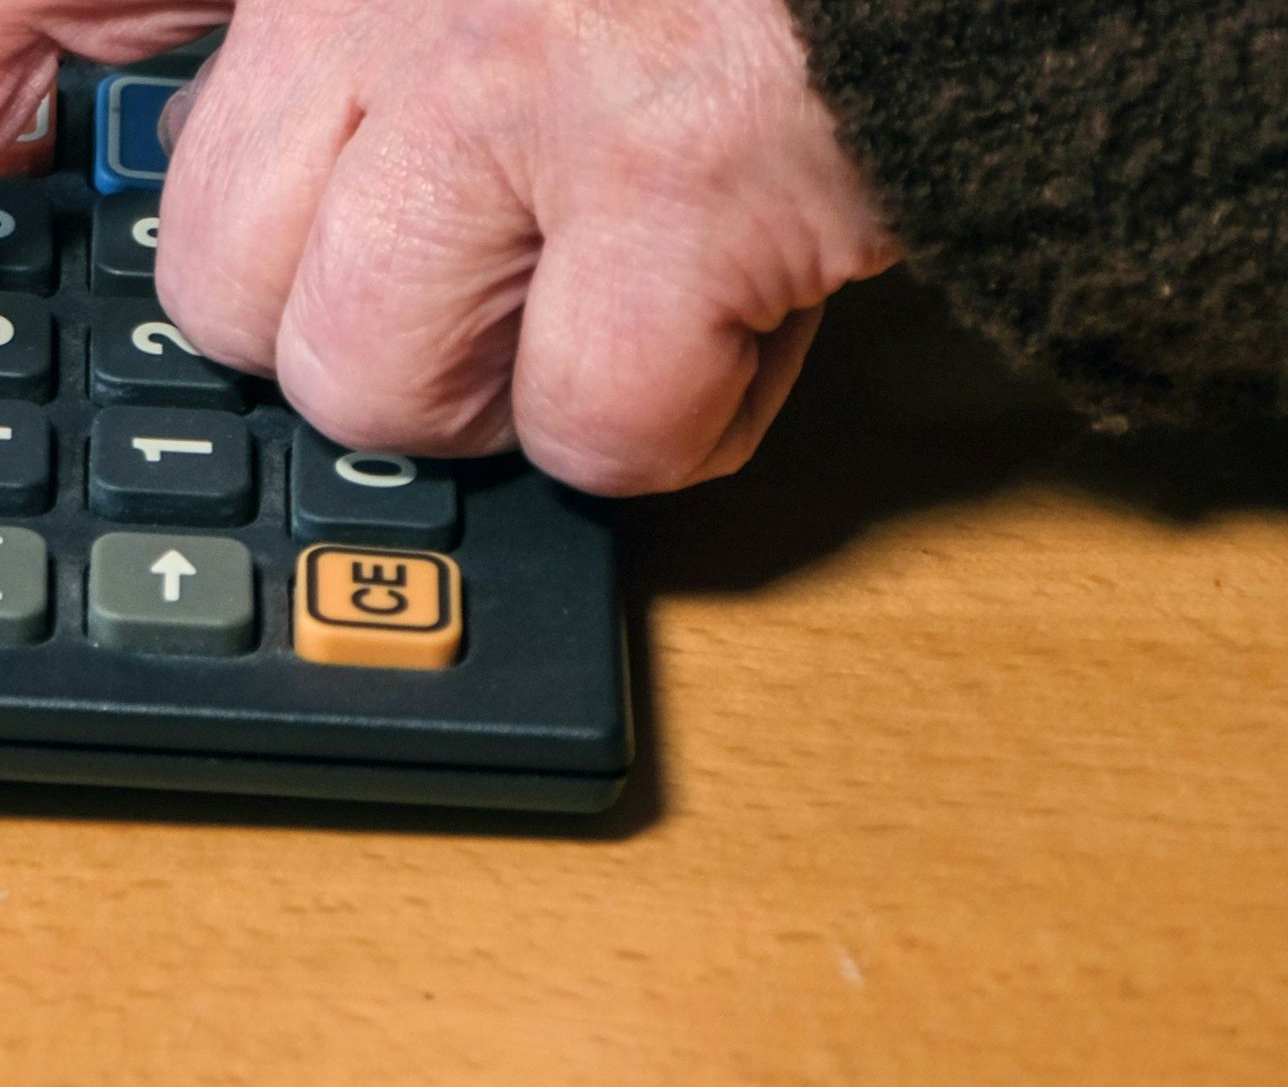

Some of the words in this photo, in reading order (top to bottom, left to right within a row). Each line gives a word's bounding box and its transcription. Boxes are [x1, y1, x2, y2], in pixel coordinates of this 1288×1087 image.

[131, 321, 200, 356] 2
[131, 436, 214, 463] 1
[334, 452, 414, 488] 0
[351, 560, 408, 615] CE
